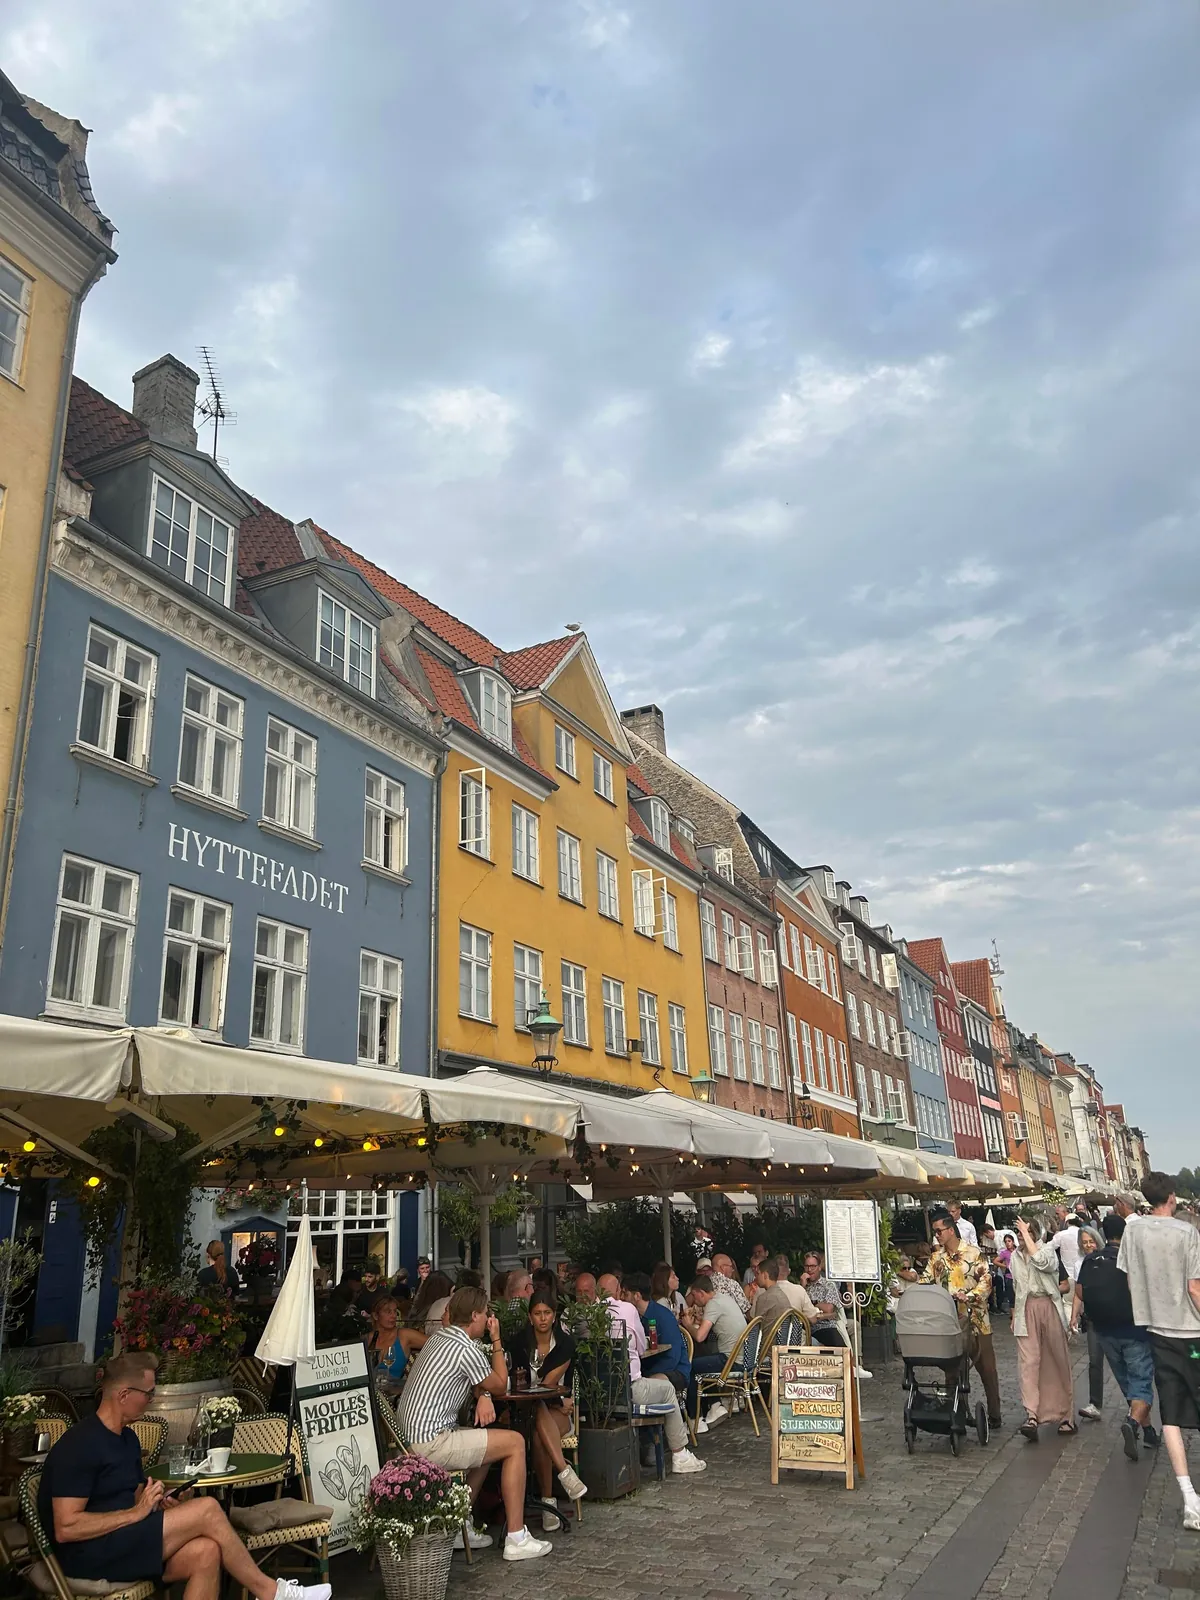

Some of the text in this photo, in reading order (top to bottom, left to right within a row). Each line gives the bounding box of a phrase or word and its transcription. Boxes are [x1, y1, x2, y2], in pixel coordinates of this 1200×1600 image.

[168, 822, 349, 914] HYTTEFADET
[783, 1357, 839, 1367] TRADITIONAL
[784, 1367, 827, 1382] Danish
[319, 1382, 340, 1391] BISTRO
[304, 1394, 366, 1421] MOULES
[305, 1408, 369, 1438] FRITES
